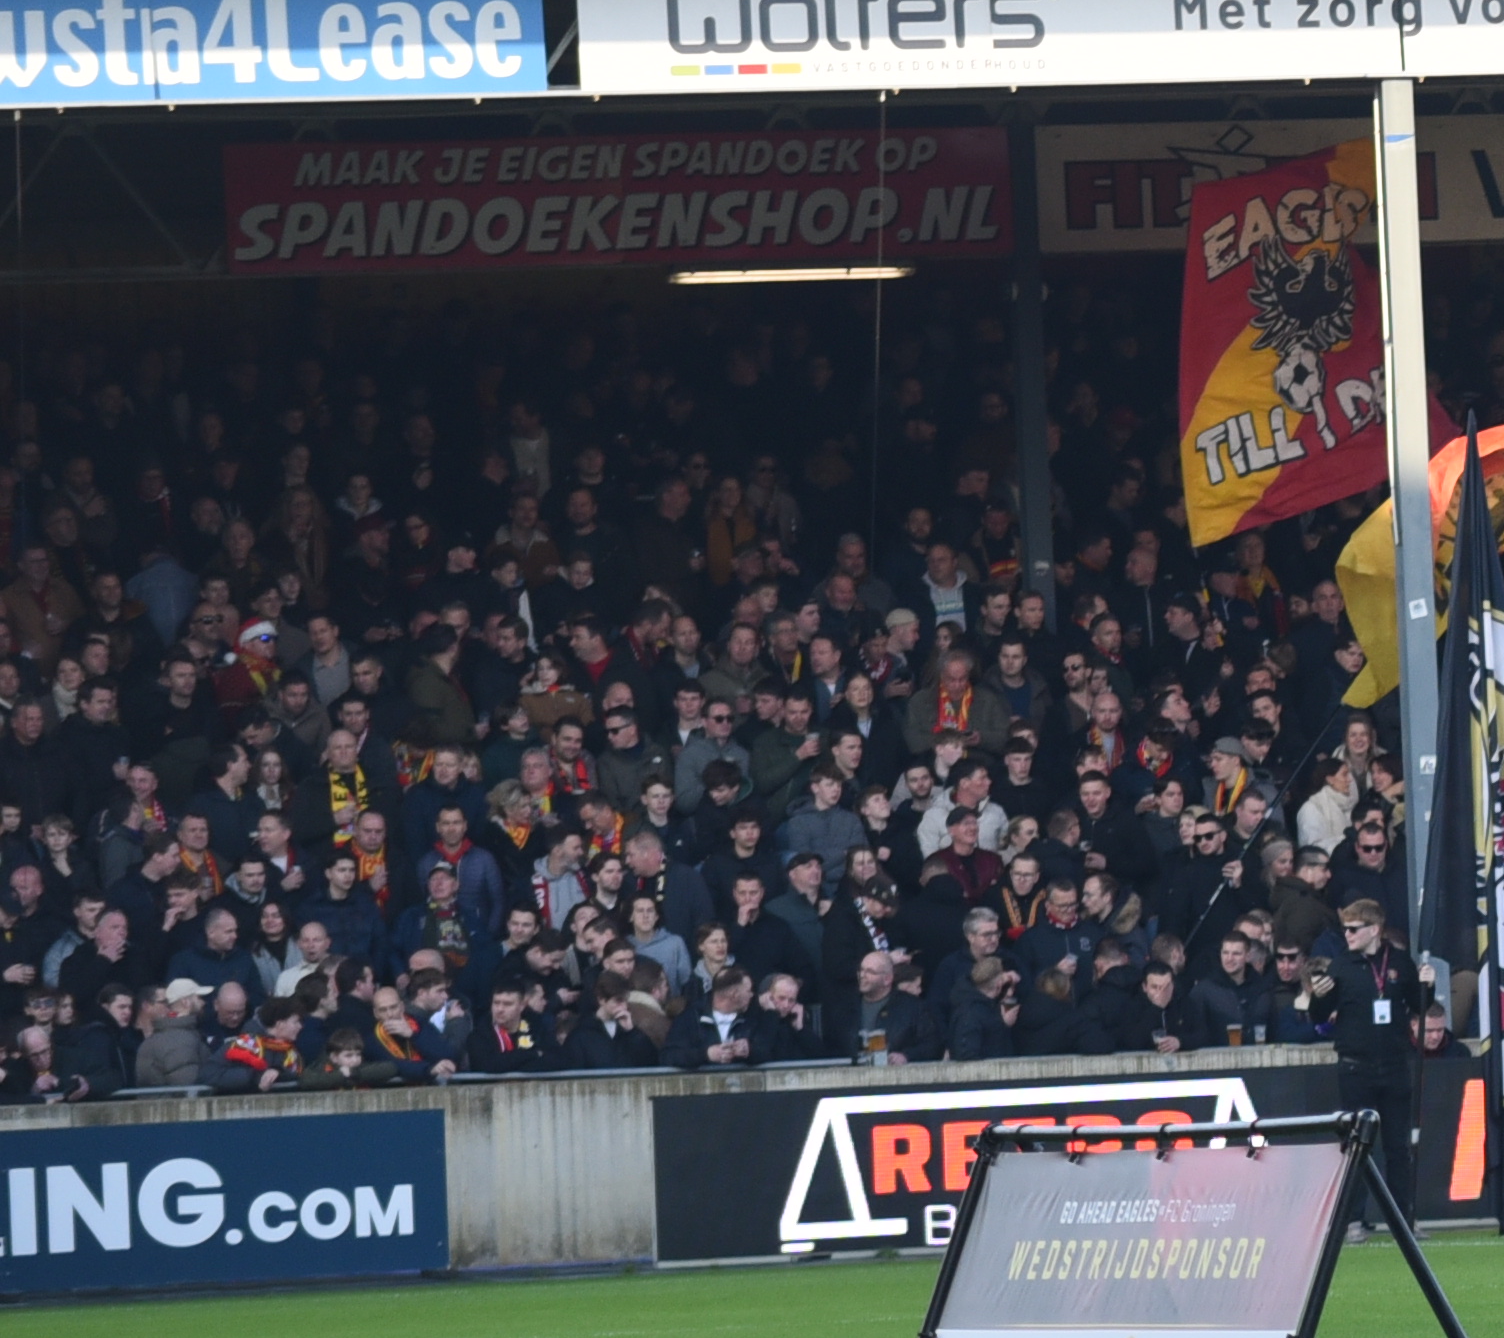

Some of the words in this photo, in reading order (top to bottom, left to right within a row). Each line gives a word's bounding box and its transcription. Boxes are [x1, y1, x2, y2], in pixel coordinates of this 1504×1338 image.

[294, 147, 424, 191] MAAK
[433, 147, 492, 186] JE
[496, 142, 626, 183] EIGEN
[633, 136, 865, 179] SPANDOEK
[876, 135, 938, 173] OP
[234, 184, 999, 261] SPANDOEKENSHOP.NL
[1196, 405, 1306, 486] TILL
[1076, 1201, 1115, 1224] AHEAD
[1115, 1199, 1160, 1224] EAGLES
[1181, 1198, 1237, 1228] Groningen
[1008, 1237, 1266, 1281] WEDSTRIJDSPONSOR
